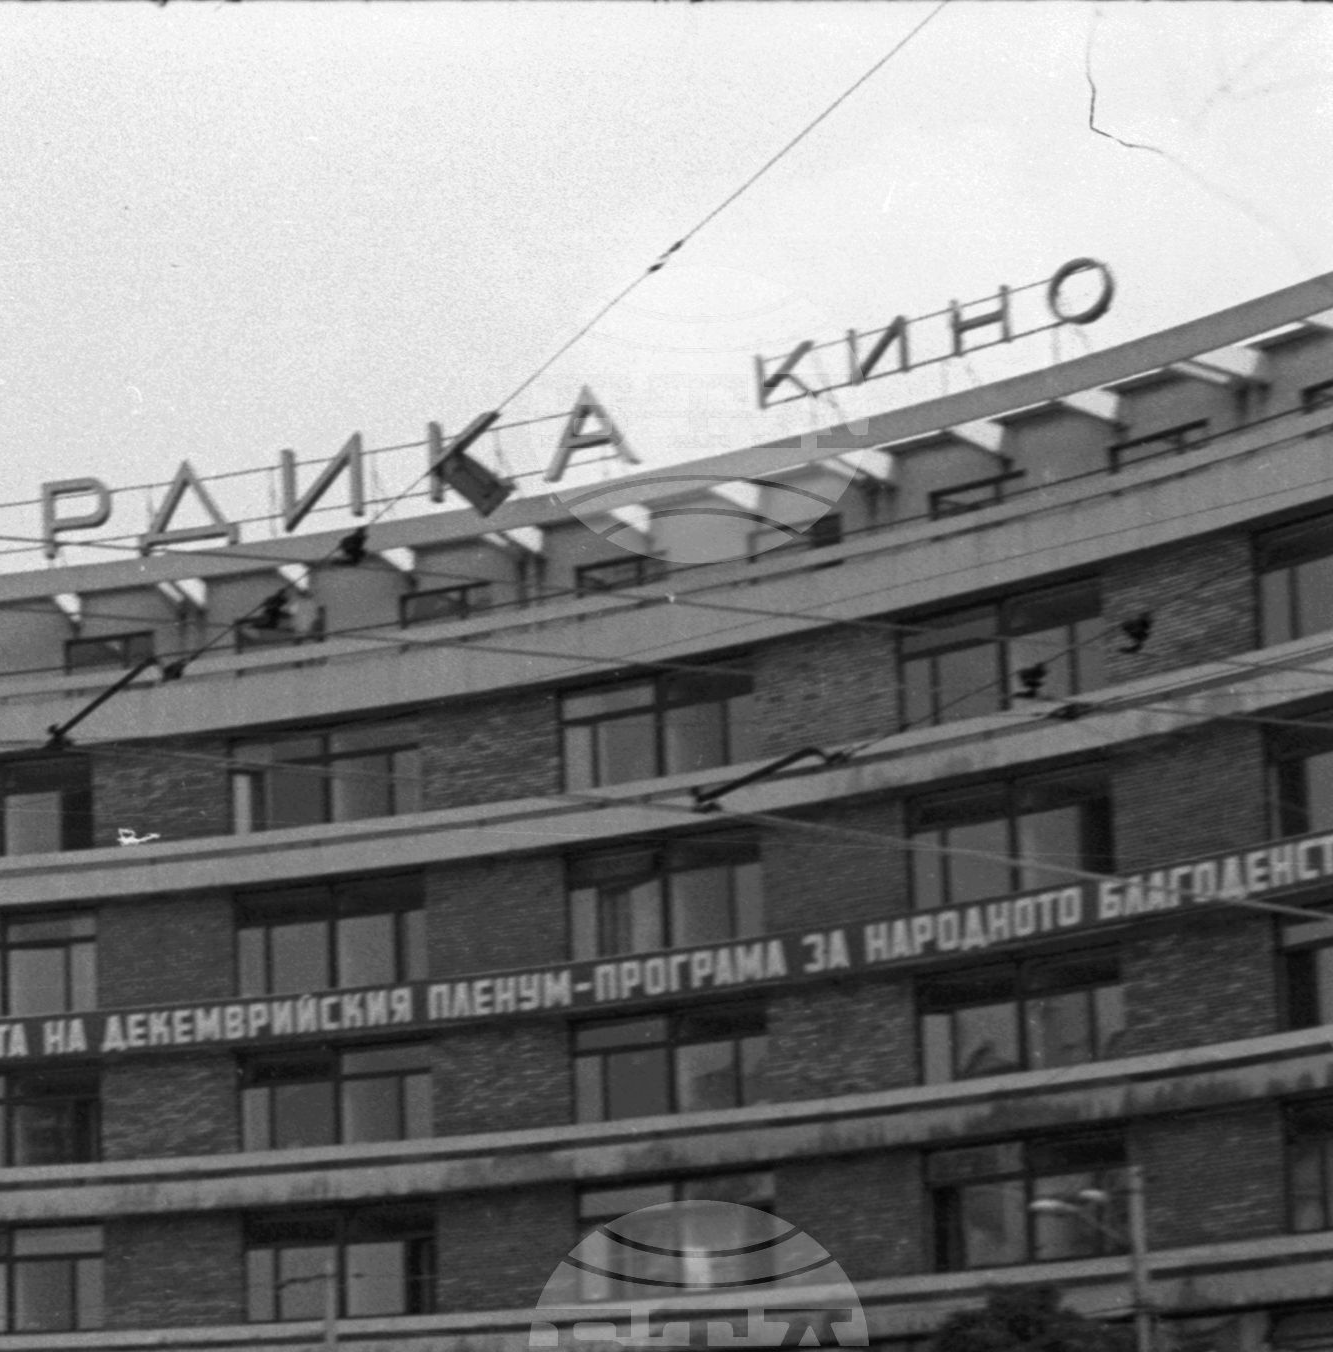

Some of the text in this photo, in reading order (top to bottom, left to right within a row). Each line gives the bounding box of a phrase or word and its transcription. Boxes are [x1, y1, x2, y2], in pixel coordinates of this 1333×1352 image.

[754, 257, 1115, 410] КИНО
[43, 1018, 87, 1055] НА
[101, 987, 412, 1051] ДЕКЕМВРИЙСКИЯ
[428, 939, 787, 1020] ПЛЕНУМ-ПРОГРАМА
[801, 929, 850, 973] ЗА
[864, 886, 1082, 963] НАРОДНОТО
